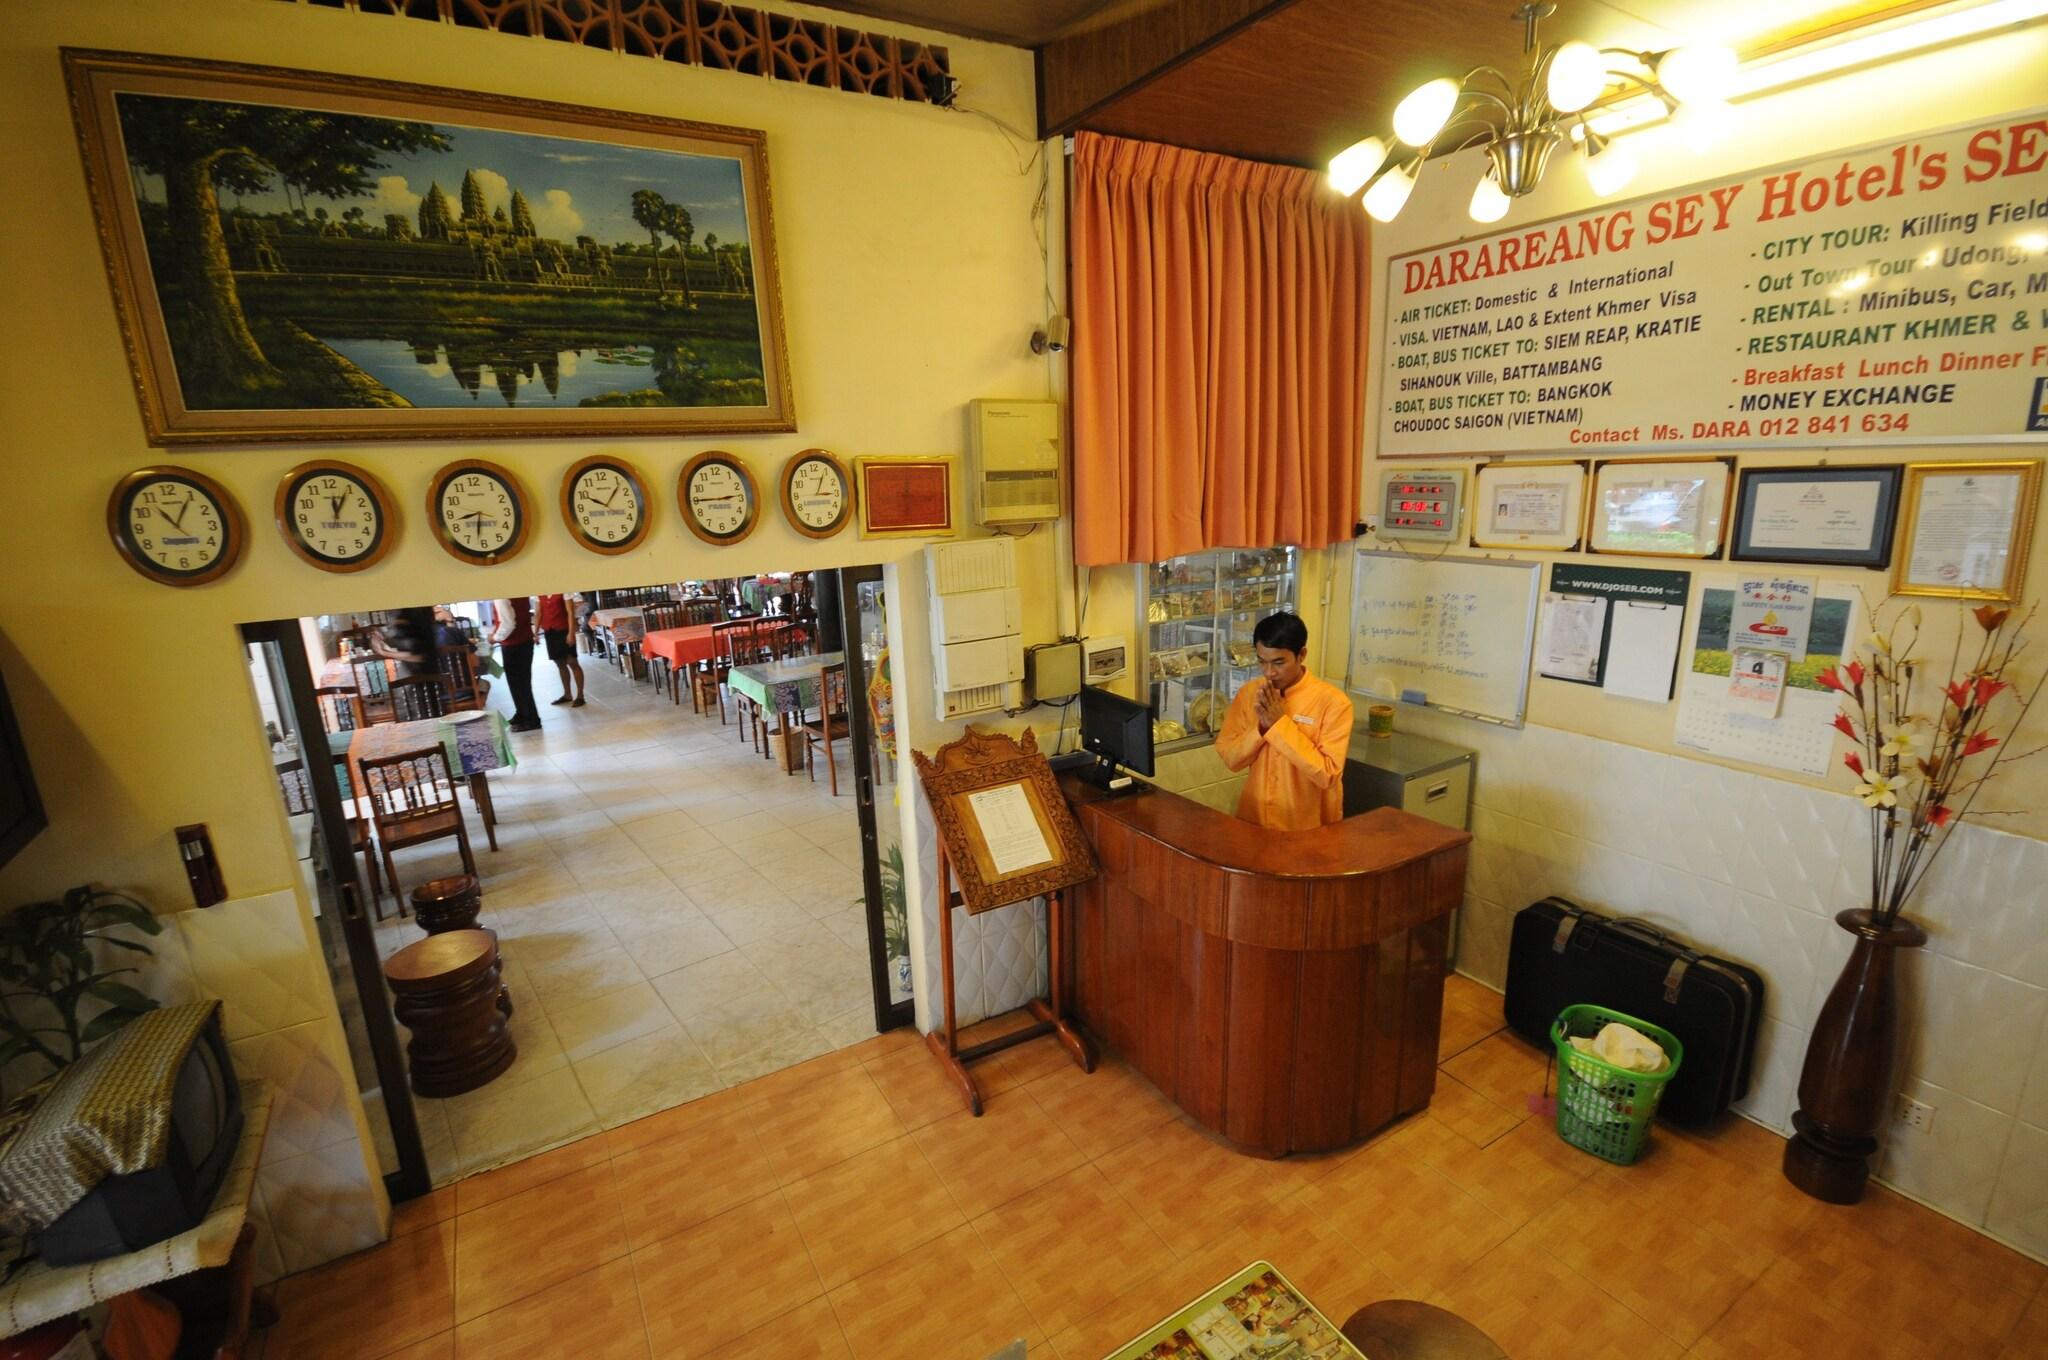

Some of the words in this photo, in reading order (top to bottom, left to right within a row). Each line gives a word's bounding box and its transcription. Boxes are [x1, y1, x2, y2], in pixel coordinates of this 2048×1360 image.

[1403, 210, 1635, 294] DARAREANG
[1646, 184, 1744, 245] SEY
[1756, 144, 1948, 222] Hotel's
[1964, 120, 2048, 184] SE
[1763, 235, 1814, 260] CITY
[1821, 223, 1891, 251] TOUR:
[1900, 212, 1978, 239] Killing
[1758, 272, 1793, 293] Out
[1801, 262, 1859, 287] Town
[1866, 258, 1917, 279] Tour
[1401, 309, 1420, 324] AIR
[1424, 300, 1471, 320] TICKET:
[1475, 288, 1537, 310] Domestic
[1548, 283, 1558, 298] &
[1569, 260, 1674, 295] International
[1859, 287, 1956, 312] Minibus,
[1967, 279, 2016, 300] Car,
[1432, 321, 1492, 341] VIETNAM,
[1496, 316, 1524, 332] LAO
[1529, 312, 1538, 327] &
[1544, 304, 1591, 325] Extent
[1597, 298, 1651, 317] Khmer
[1660, 290, 1697, 308] Visa
[1748, 323, 1897, 355] RESTAURANT
[1904, 314, 1997, 340] KHMER
[2012, 310, 2029, 331] &
[1398, 352, 1430, 368] BOAT,
[1433, 349, 1457, 364] BUS
[1462, 342, 1510, 360] TICKET
[1516, 339, 1538, 354] TO:
[1544, 332, 1580, 350] SIEM
[1585, 325, 1630, 345] REAP,
[1635, 315, 1702, 339] KRATIE
[1400, 372, 1461, 391] SIHANOUK
[1466, 370, 1497, 385] Ville,
[1503, 356, 1602, 381] BATTAMBANG
[1744, 362, 1845, 386] Breakfast
[1858, 354, 1929, 377] Lunch
[1940, 352, 2024, 372] Dinner
[1395, 398, 1426, 414] BOAT,
[1430, 396, 1453, 410] BUS
[1458, 392, 1505, 408] TICKET
[1509, 390, 1531, 404] TO:
[1537, 381, 1612, 402] BANGKOK
[1740, 390, 1817, 411] MONEY
[1822, 384, 1956, 407] EXCHANGE
[1394, 418, 1450, 433] CHOUDOC
[1454, 413, 1504, 430] SAIGON
[1508, 408, 1583, 430] (VIETNAM)
[1569, 426, 1640, 444] Contact
[1652, 424, 1684, 441] Ms.
[1692, 420, 1751, 439] DARA
[1760, 417, 1799, 436] 012
[1808, 415, 1851, 434] 841
[1861, 413, 1909, 432] 634
[466, 476, 481, 487] 12
[595, 472, 607, 481] 12
[615, 476, 620, 486] 1
[321, 479, 337, 489] 12
[454, 483, 465, 493] 11
[488, 481, 494, 492] 1
[583, 478, 594, 488] 11
[159, 484, 176, 496] 12
[307, 485, 320, 496] 11
[346, 484, 353, 495] 1
[622, 487, 630, 497] 2
[142, 492, 157, 503] 11
[187, 491, 195, 501] 1
[447, 495, 460, 506] 10
[498, 494, 506, 504] 2
[299, 498, 314, 510] 10
[357, 497, 367, 508] 2
[627, 500, 634, 509] 3
[134, 507, 150, 518] 10
[200, 505, 210, 515] 2
[503, 507, 511, 517] 3
[577, 504, 585, 513] 9
[298, 513, 308, 524] 9
[363, 511, 372, 522] 3
[446, 510, 455, 520] 9
[583, 516, 590, 525] 8
[626, 513, 633, 521] 4
[134, 523, 144, 535] 9
[208, 520, 218, 531] 3
[362, 526, 371, 536] 4
[452, 523, 461, 533] 8
[502, 521, 510, 530] 4
[621, 524, 629, 533] 5
[305, 527, 315, 538] 8
[593, 527, 600, 536] 7
[607, 530, 615, 540] 6
[207, 536, 216, 547] 4
[464, 534, 472, 544] 7
[495, 533, 504, 543] 5
[143, 539, 153, 550] 8
[319, 540, 327, 551] 7
[354, 539, 364, 549] 5
[480, 539, 488, 549] 6
[199, 551, 209, 561] 5
[337, 545, 347, 556] 6
[158, 552, 168, 563] 7
[180, 557, 190, 568] 6
[1571, 580, 1664, 595] WWW.DJOSER.COM
